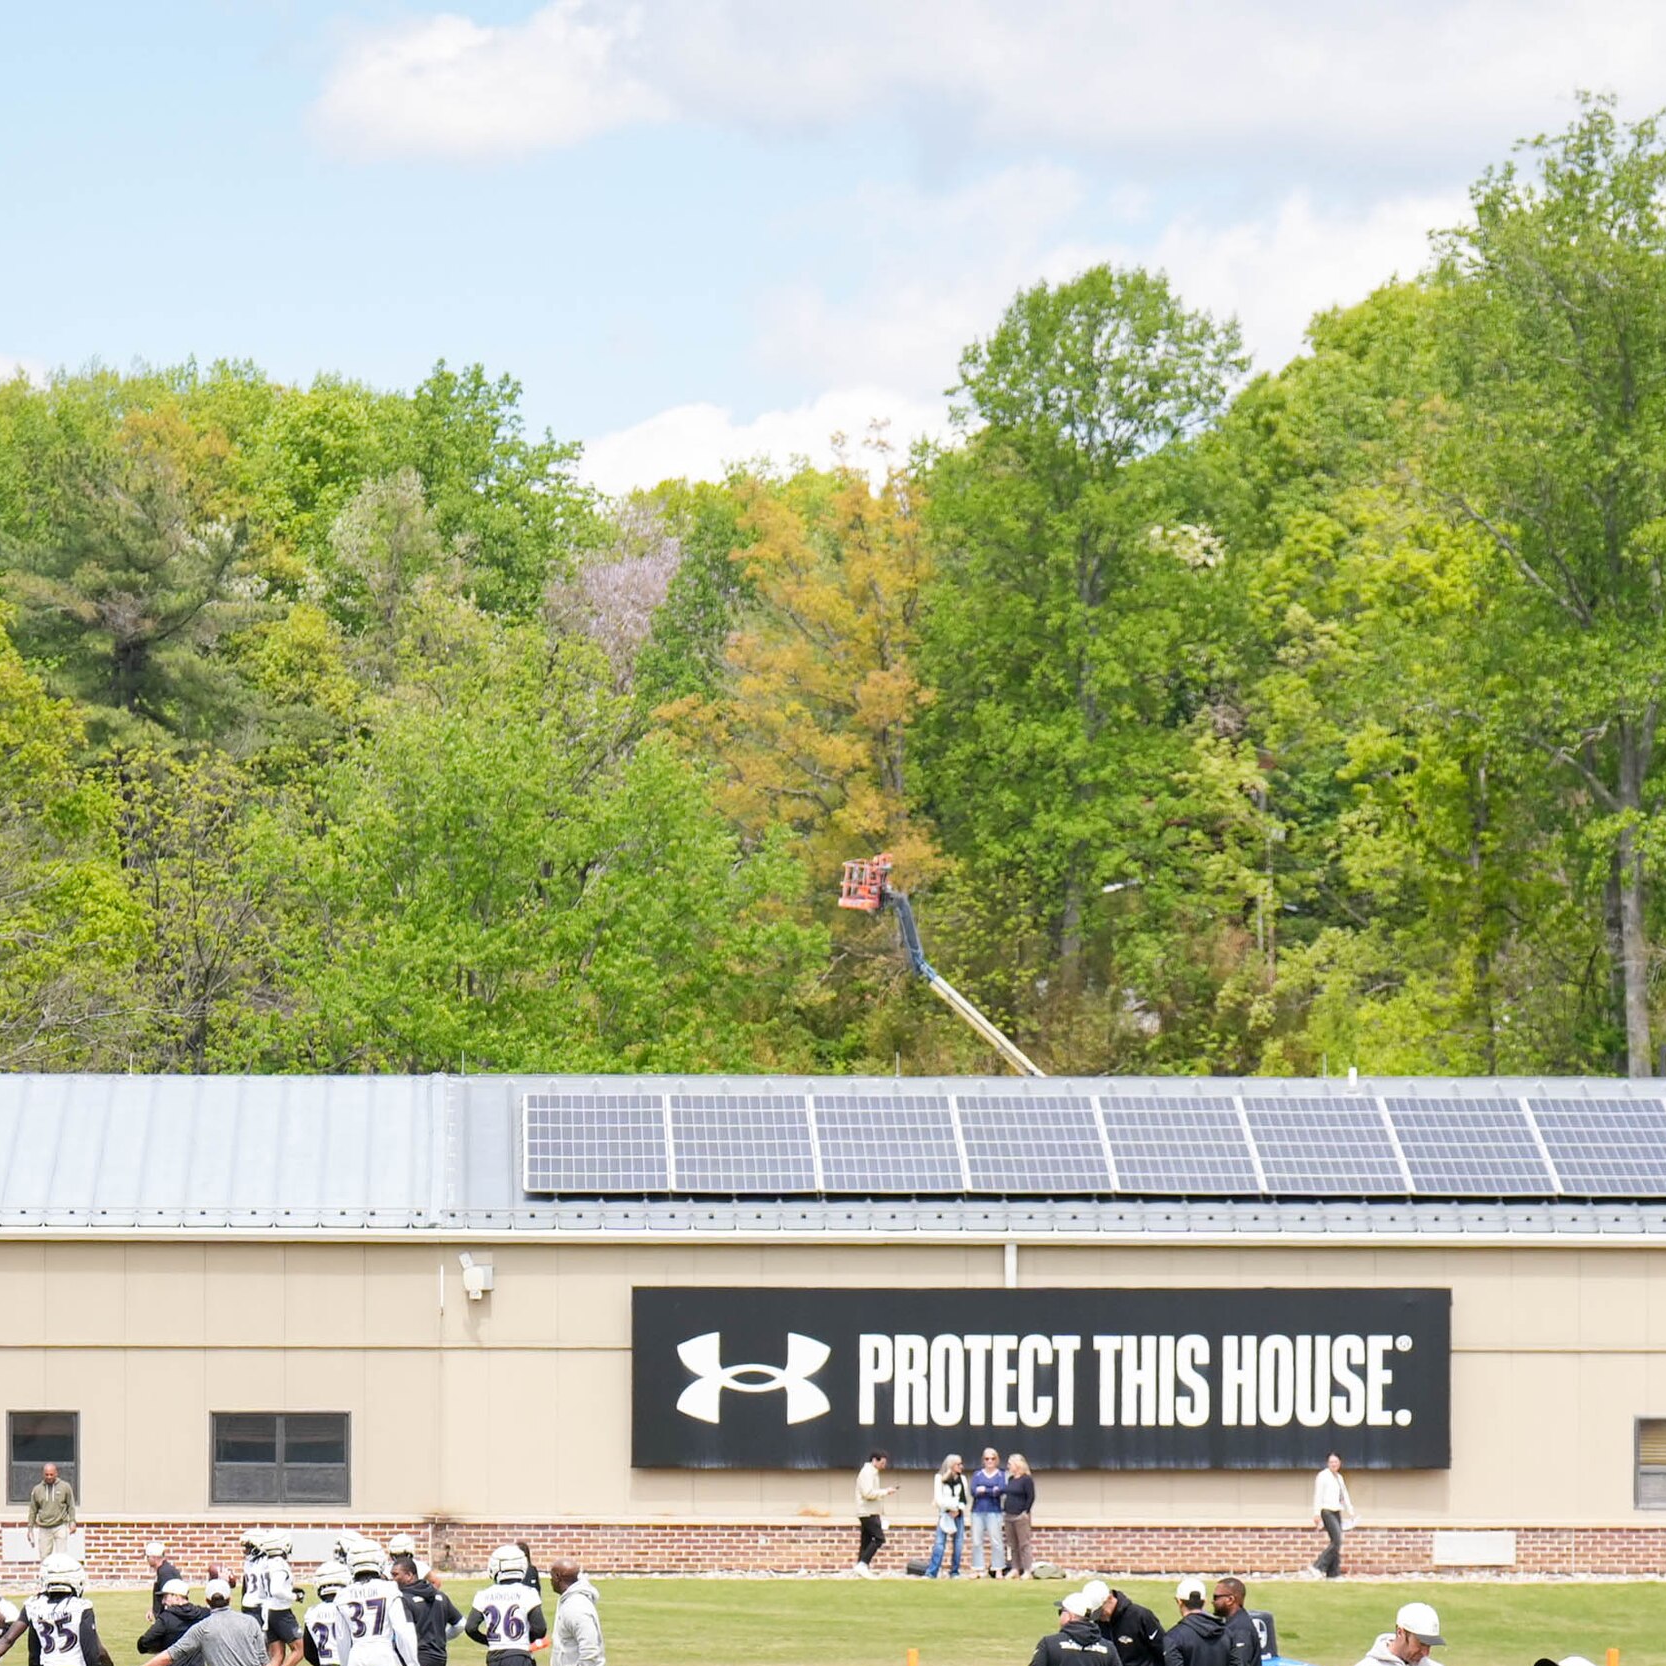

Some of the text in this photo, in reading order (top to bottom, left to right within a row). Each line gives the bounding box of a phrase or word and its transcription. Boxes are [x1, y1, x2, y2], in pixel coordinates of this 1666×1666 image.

[858, 1333, 1081, 1427] PROTECT
[1092, 1333, 1210, 1427] THIS
[37, 1612, 78, 1654] 35
[347, 1597, 387, 1638] 37
[483, 1604, 525, 1641] 26
[312, 1621, 336, 1659] 2
